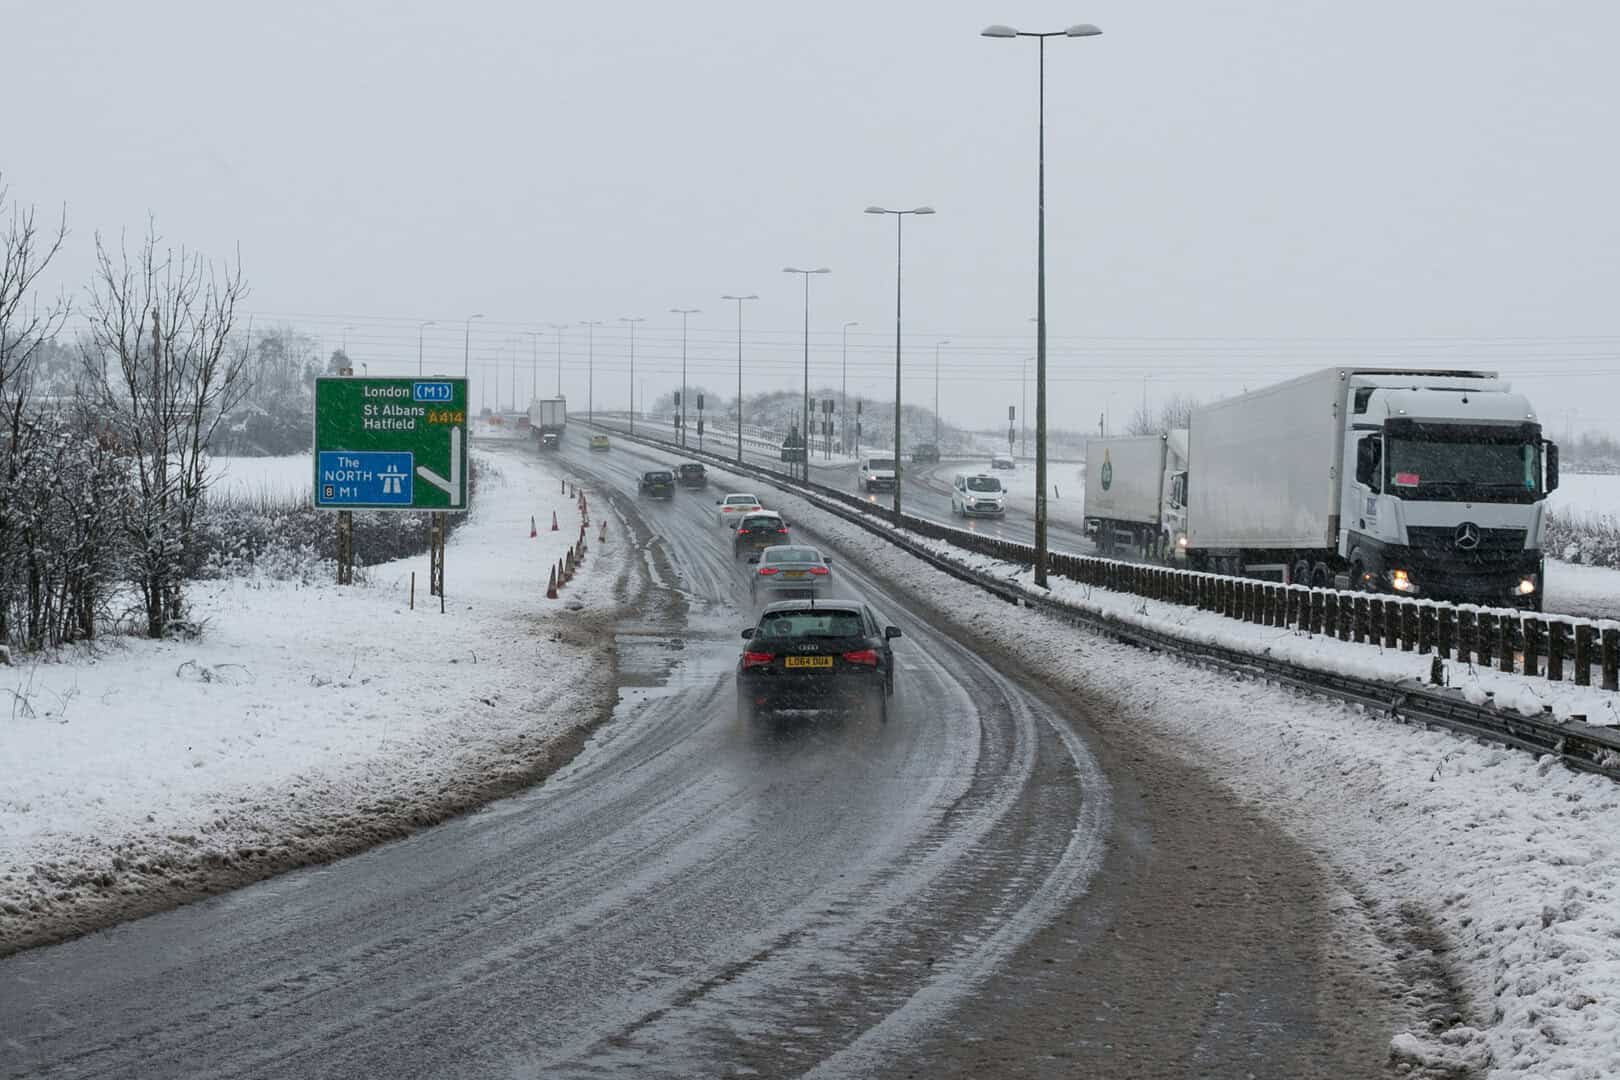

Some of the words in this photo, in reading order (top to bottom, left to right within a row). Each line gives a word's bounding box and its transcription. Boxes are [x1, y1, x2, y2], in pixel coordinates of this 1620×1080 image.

[364, 386, 410, 397] London
[416, 385, 450, 399] (M1)
[364, 404, 378, 416] St
[382, 404, 425, 416] Albans
[429, 411, 464, 423] A414
[364, 418, 415, 430] Hatfield
[337, 456, 360, 468] The
[324, 470, 372, 481] NORTH
[326, 487, 333, 497] 8
[340, 487, 358, 497] M1
